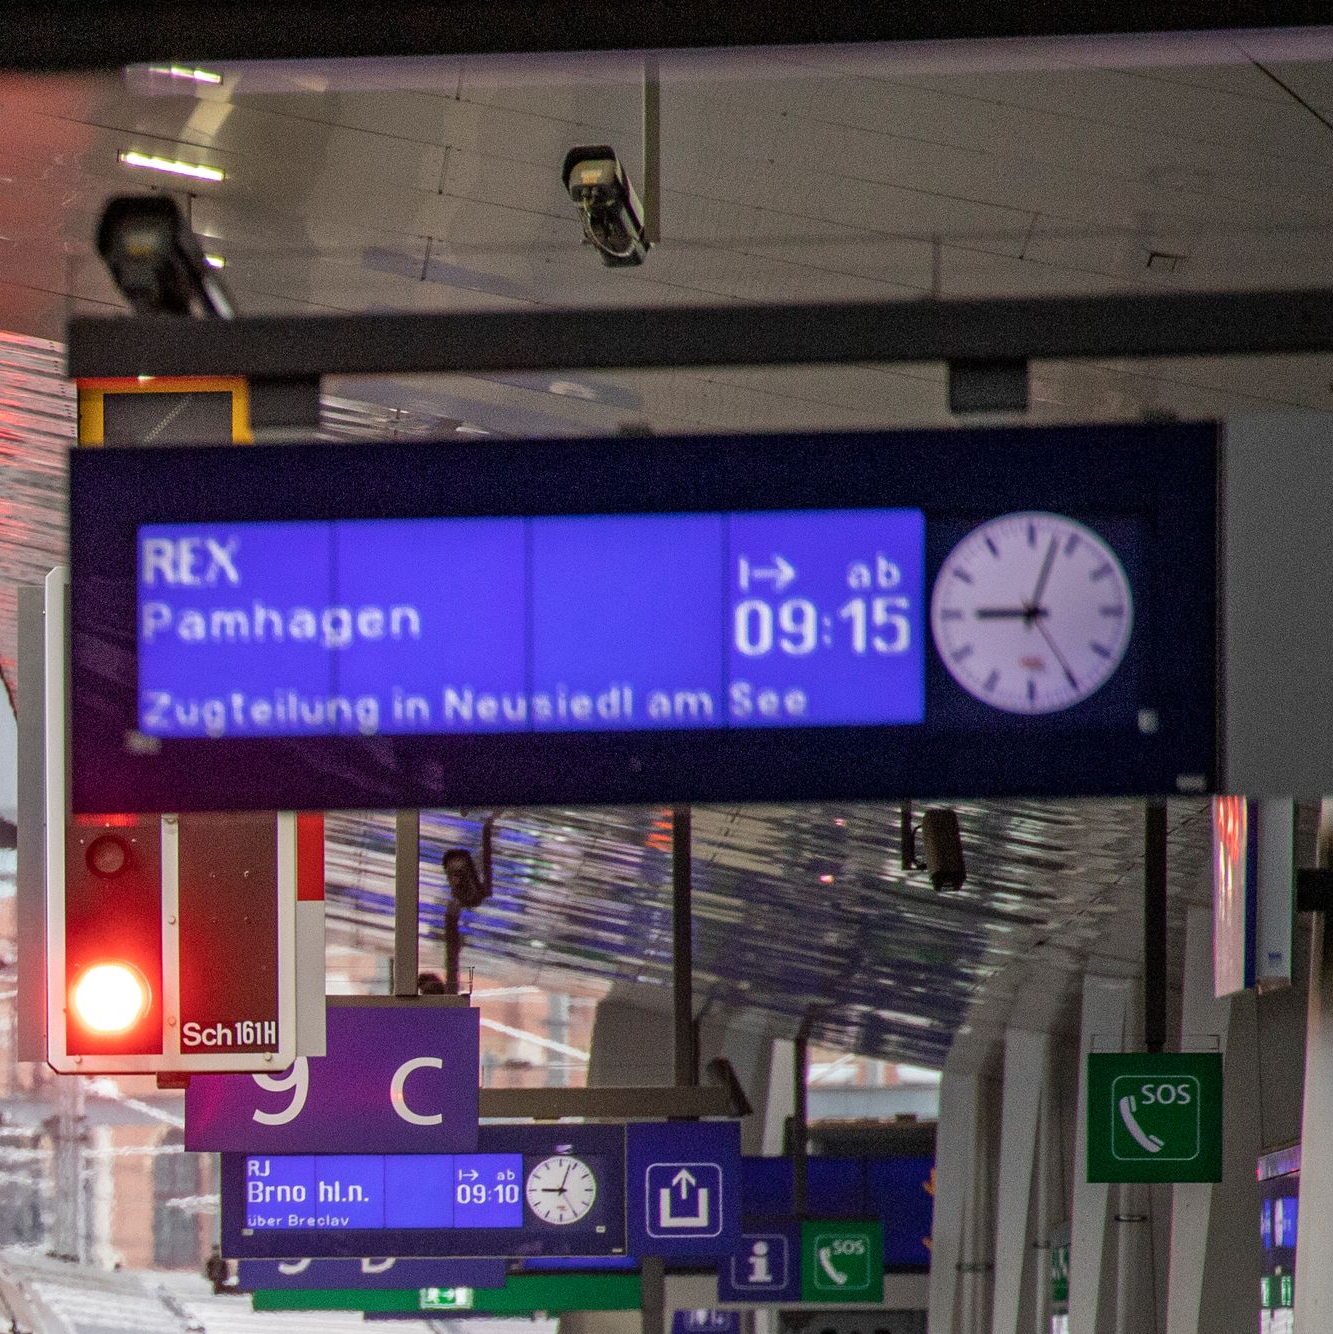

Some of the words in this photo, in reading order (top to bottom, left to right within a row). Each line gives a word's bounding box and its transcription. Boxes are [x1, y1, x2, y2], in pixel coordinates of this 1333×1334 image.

[142, 537, 240, 586] REX
[847, 552, 901, 590] ab
[143, 599, 422, 650] Pamhagen
[734, 597, 912, 656] 09:15
[143, 691, 380, 740] Zugteilung
[393, 688, 431, 724] in
[443, 683, 634, 728] Neusiedl
[649, 689, 714, 721] am
[730, 681, 809, 719] See
[390, 1056, 443, 1126] C
[1141, 1083, 1191, 1105] SOS
[247, 1160, 271, 1178] RJ
[497, 1169, 516, 1182] ab
[247, 1181, 306, 1203] Brno
[318, 1181, 370, 1203] hl.n.
[456, 1183, 520, 1205] 09:10
[247, 1214, 283, 1228] über
[288, 1214, 350, 1227] Breclav
[832, 1240, 865, 1256] SOS
